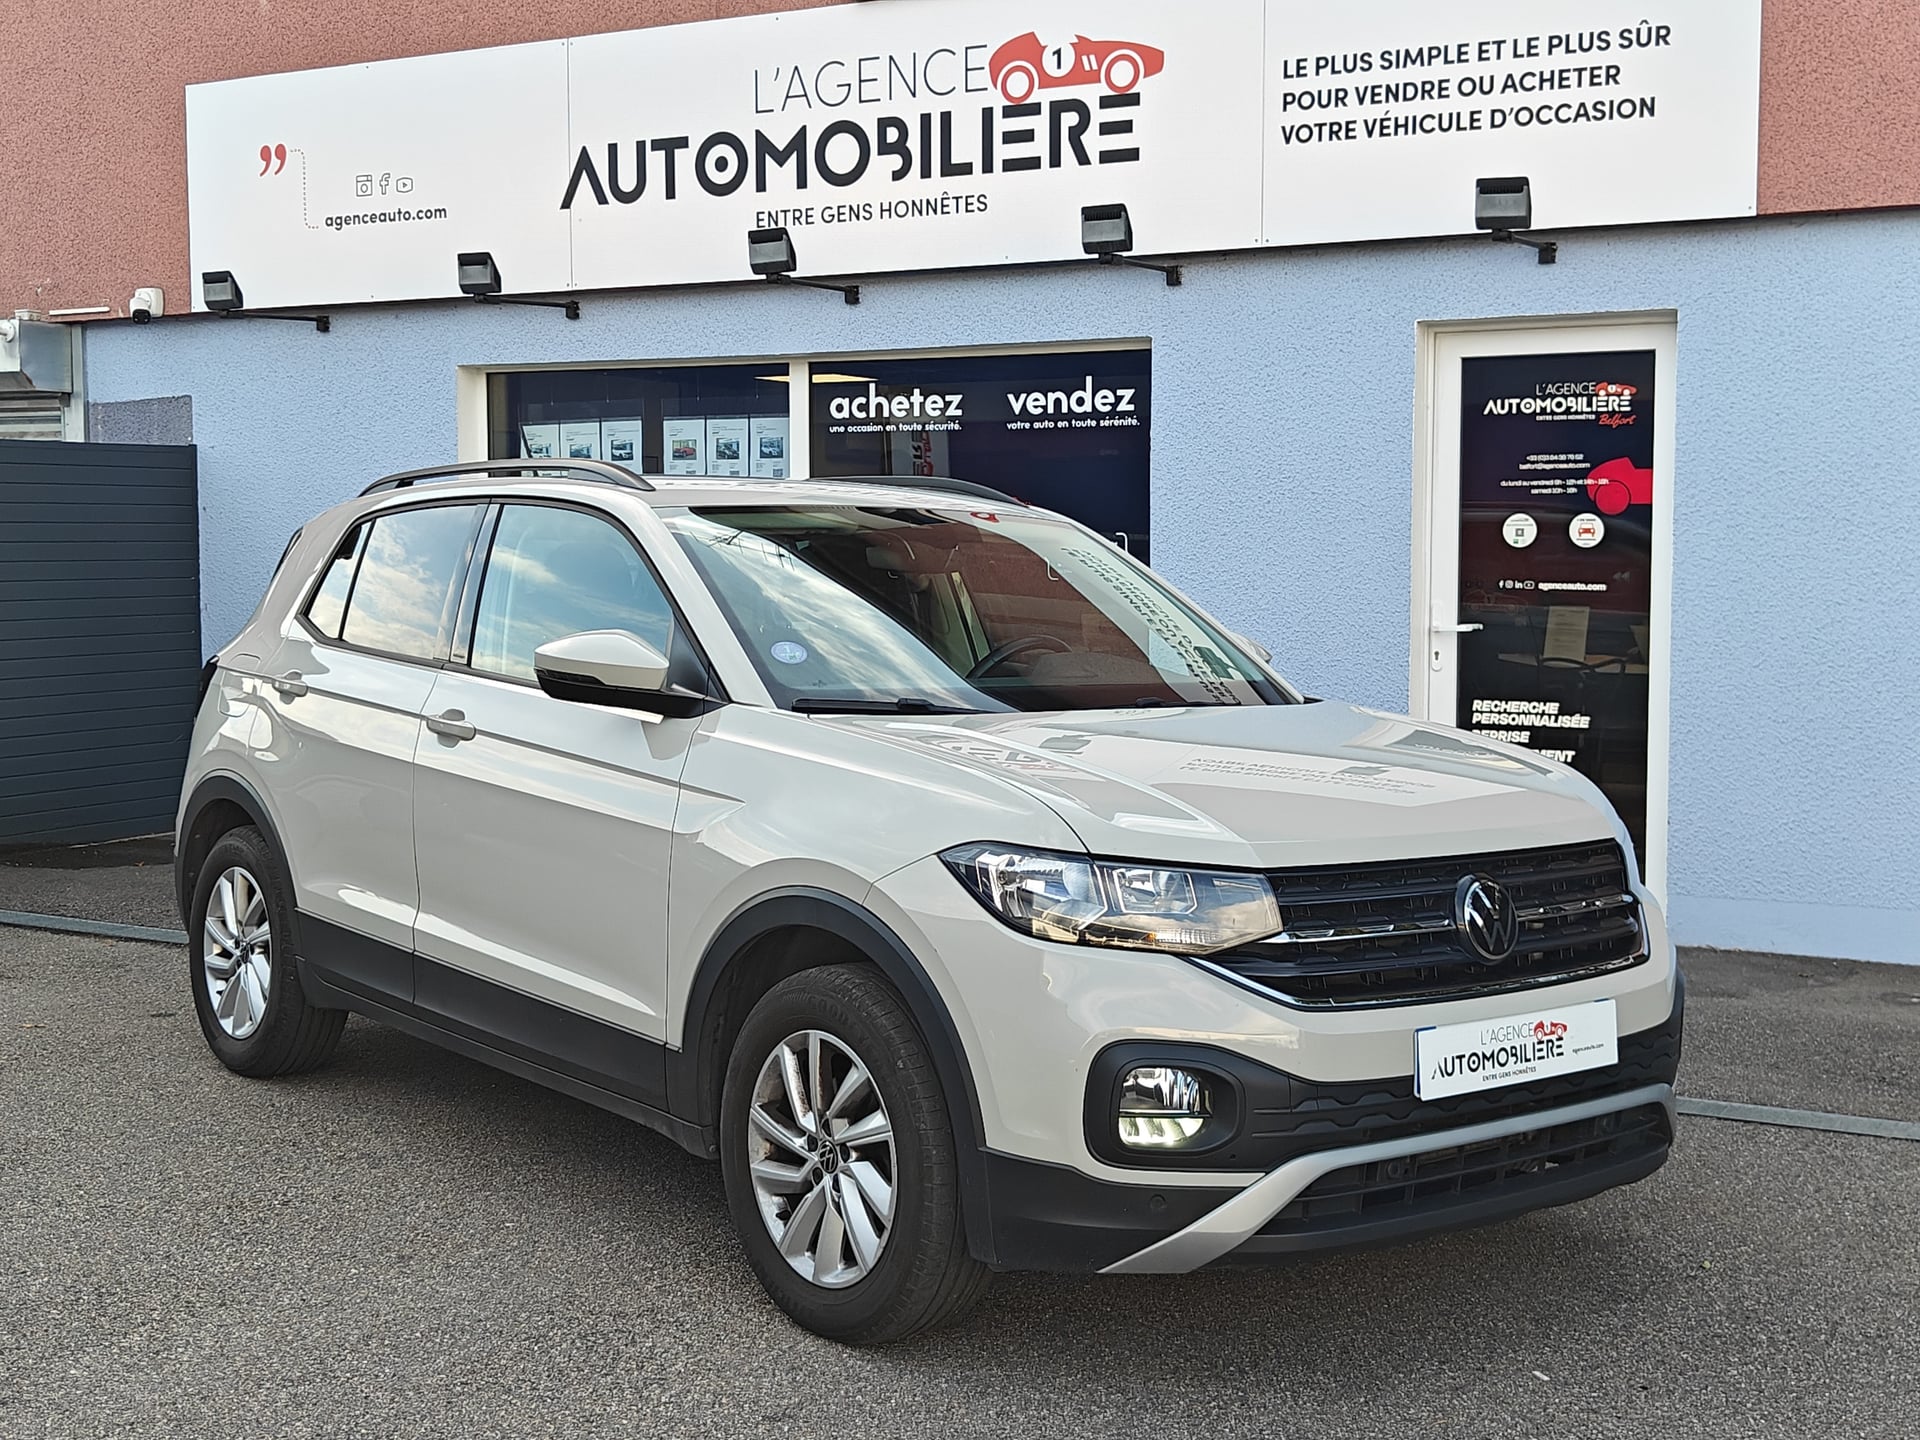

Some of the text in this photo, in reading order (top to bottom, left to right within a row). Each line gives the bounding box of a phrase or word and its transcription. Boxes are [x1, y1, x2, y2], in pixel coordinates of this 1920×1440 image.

[1283, 19, 1672, 79] LE PLUS SIMPLE ET LE PLUS SÛR
[755, 45, 989, 114] L'AGENCE
[1282, 64, 1621, 113] POUR VENDRE OU ACHETER
[1281, 97, 1656, 145] VOTRE VÉHICULE D'OCCASION
[325, 205, 447, 231] agenceauto.com
[756, 191, 988, 229] ENTRE GENS HONNÊTES
[829, 382, 963, 419] achetez
[1007, 375, 1136, 415] vendez
[1536, 382, 1596, 396] L'AGENCE
[829, 419, 962, 433] une occasion en toute sécurité.
[1007, 415, 1140, 430] votre auto en toute sérénité.
[1599, 413, 1635, 428] Belfort
[1472, 699, 1560, 715] RECHERCHE
[1472, 713, 1591, 729] PERSONNALISÉE
[1480, 1021, 1535, 1046] L'AGENCE
